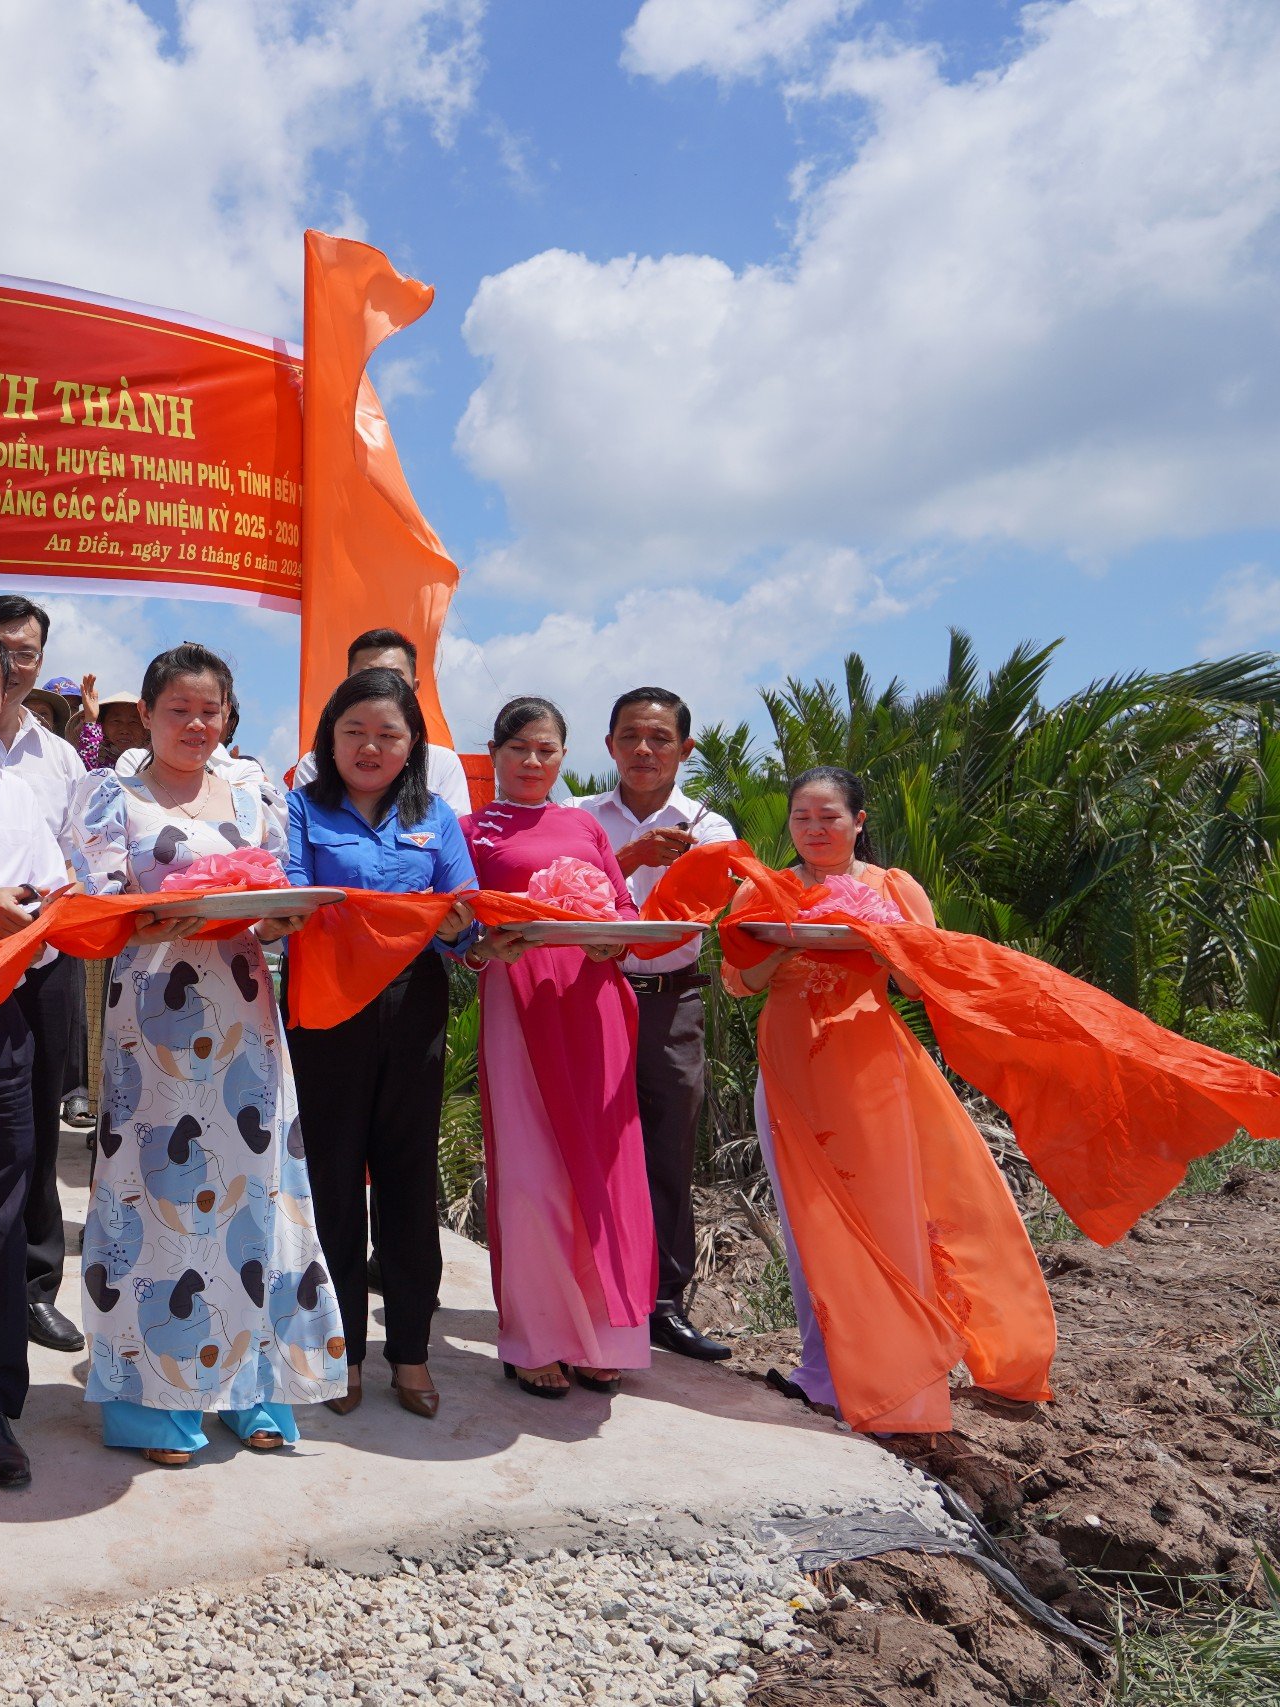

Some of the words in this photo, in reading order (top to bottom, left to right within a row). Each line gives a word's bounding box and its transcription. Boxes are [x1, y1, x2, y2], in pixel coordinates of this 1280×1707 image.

[53, 376, 196, 440] THÀNH
[56, 444, 125, 481] HUYỆN
[130, 454, 193, 490] THẠNH
[197, 459, 235, 496] PHÚ,
[237, 462, 271, 499] TỈNH
[274, 470, 297, 506] BẾN
[52, 487, 96, 521] CÁC
[101, 488, 140, 523] CẤP
[145, 498, 204, 535] NHIỆM
[208, 502, 230, 533] KỲ
[234, 511, 266, 540] 2025
[275, 520, 300, 548] 2030
[45, 533, 72, 551] An
[77, 531, 124, 557] Điền,
[130, 540, 173, 563] ngày
[178, 543, 196, 560] 18
[201, 545, 242, 570] tháng
[244, 551, 252, 567] 6
[255, 554, 278, 573] năm
